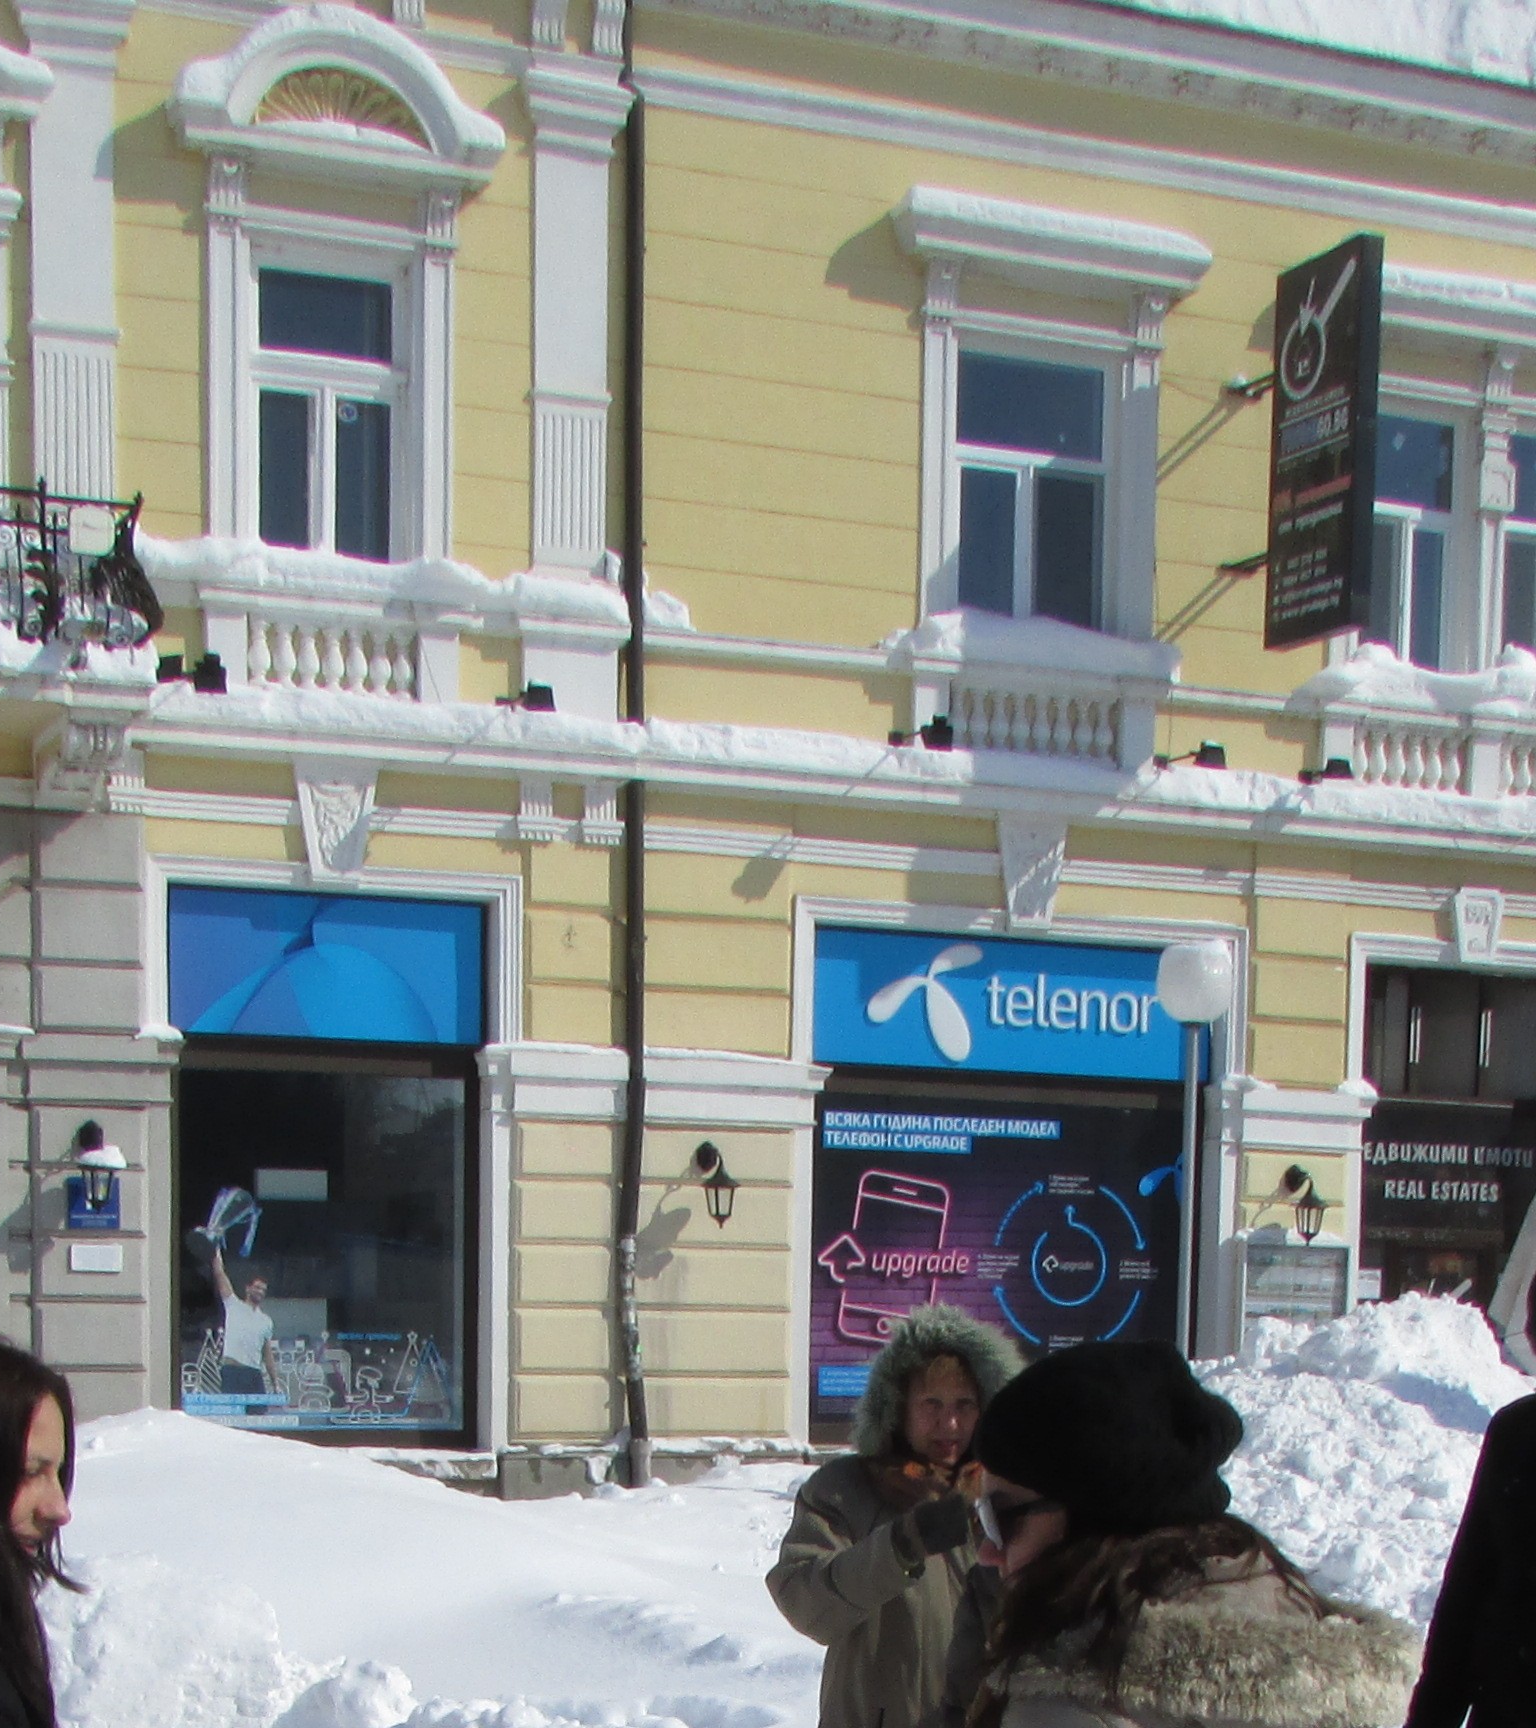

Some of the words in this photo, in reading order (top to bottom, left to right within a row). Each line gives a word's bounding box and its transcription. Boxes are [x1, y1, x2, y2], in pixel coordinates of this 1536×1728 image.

[986, 973, 1161, 1035] telenor
[825, 1111, 871, 1128] ВСЯКА
[872, 1112, 932, 1131] ГОДИНА
[933, 1115, 1005, 1135] ПОСЛЕДЕН
[1007, 1119, 1058, 1138] МОДЕЛ
[824, 1131, 891, 1147] ТЕЛЕФОН
[904, 1134, 968, 1151] UPGRADE
[1364, 1140, 1469, 1166] ЕДВИЖИМИ
[1383, 1179, 1426, 1200] REAL
[1430, 1180, 1500, 1203] ESTATES
[871, 1249, 970, 1279] upgrade
